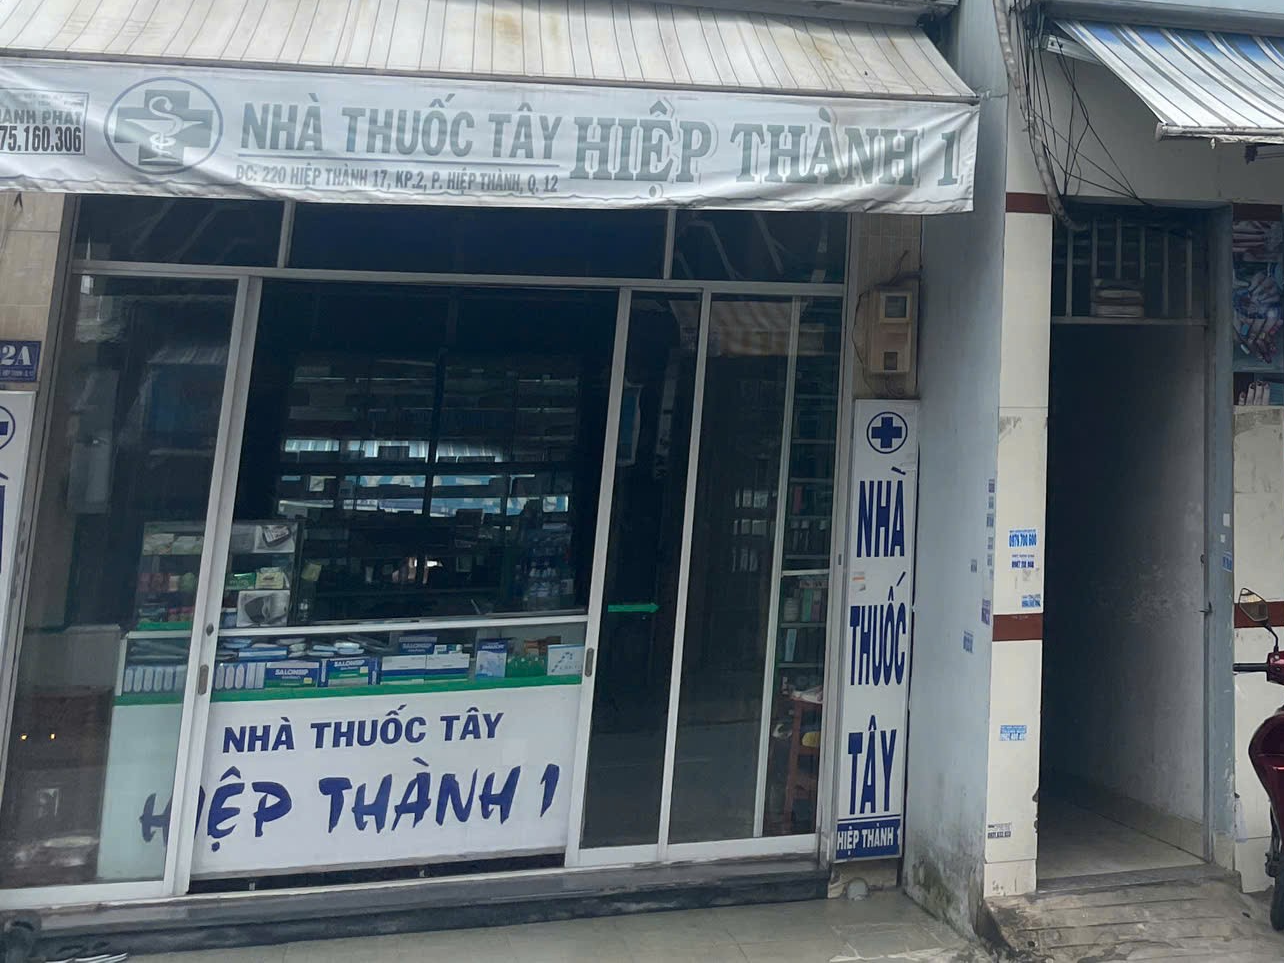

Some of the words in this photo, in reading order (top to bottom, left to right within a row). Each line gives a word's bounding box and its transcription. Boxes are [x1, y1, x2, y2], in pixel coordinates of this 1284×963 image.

[240, 93, 322, 152] NHÀ
[342, 93, 476, 158] THUỐC
[488, 102, 565, 160] TÂY
[569, 98, 718, 198] HIỆP
[731, 106, 921, 188] THÀNH
[937, 130, 964, 187] 1
[262, 166, 286, 183] 220
[290, 163, 322, 187] HIỆP
[325, 165, 368, 186] THÀNH
[447, 170, 476, 194] HIỆP
[480, 169, 523, 193] THÀNH,
[544, 175, 558, 192] 12
[856, 466, 906, 558] NHÀ
[849, 571, 906, 687] THUỐC
[222, 717, 296, 754] NHÀ
[310, 704, 427, 749] THUỐC
[440, 706, 504, 741] TÂY
[848, 714, 898, 816] TÂY
[318, 757, 521, 834] THÀNH
[540, 764, 560, 817] 1
[837, 825, 860, 856] HIỆP
[862, 822, 895, 848] THÀNH
